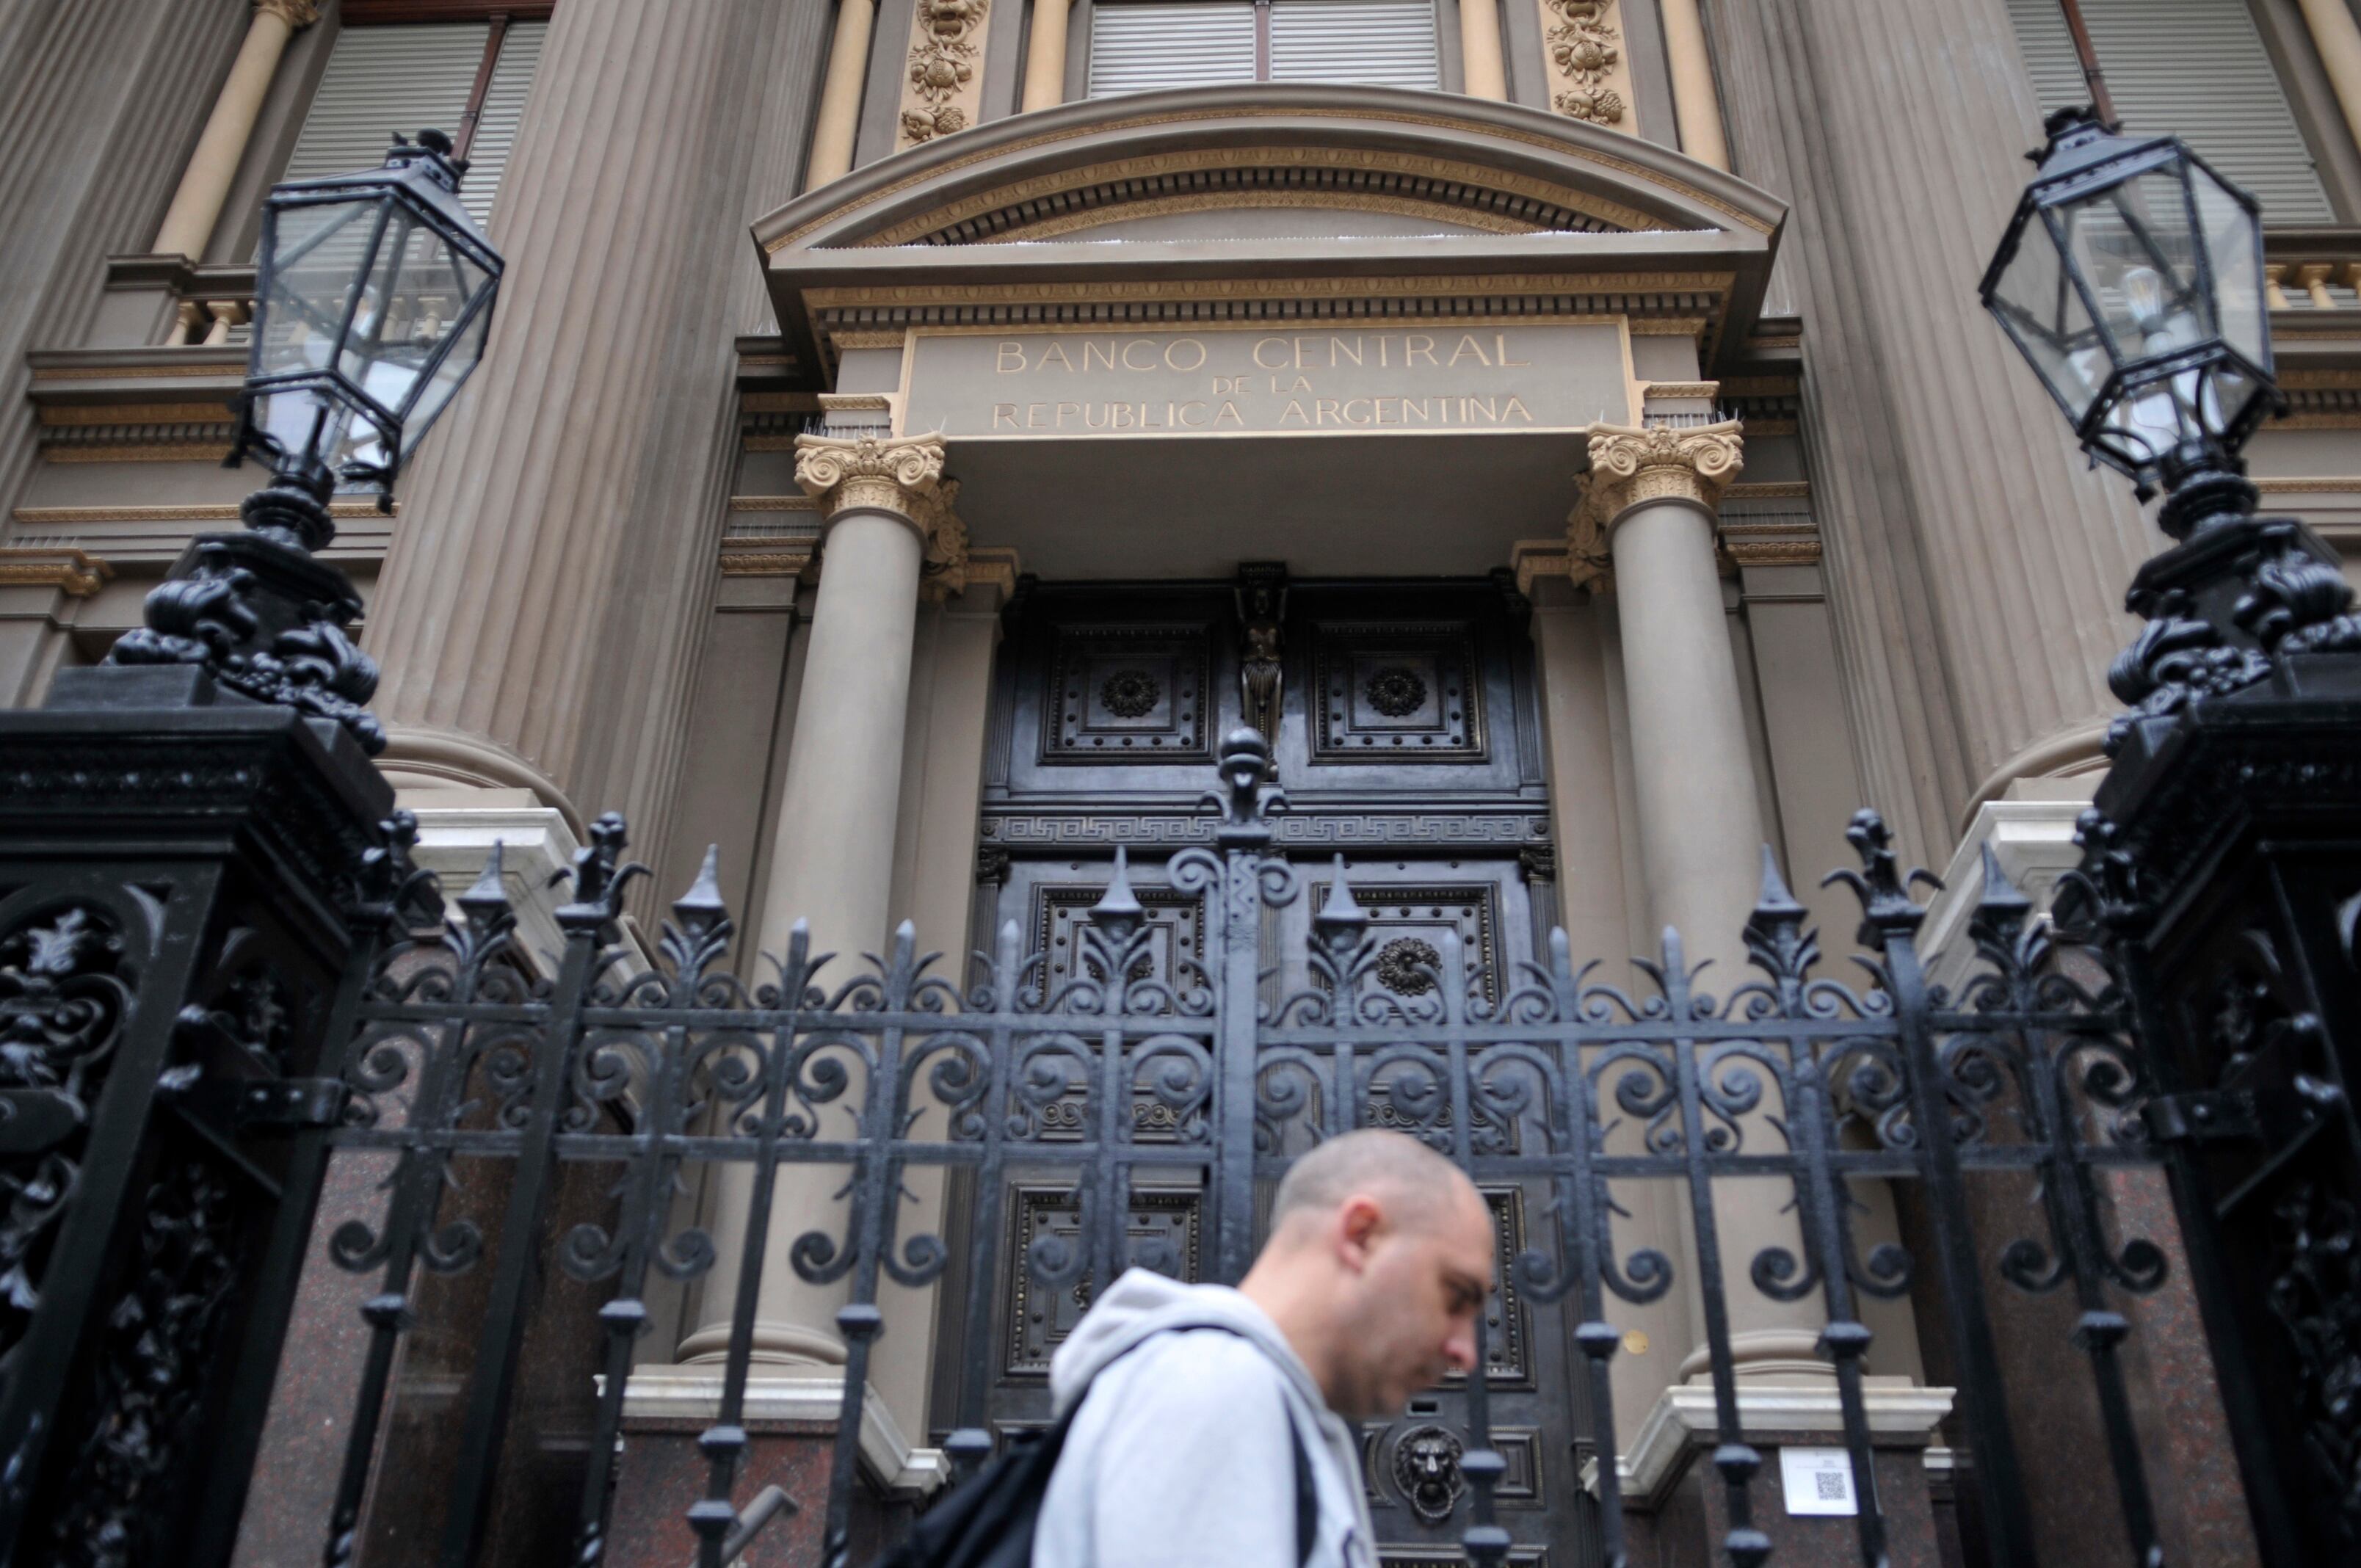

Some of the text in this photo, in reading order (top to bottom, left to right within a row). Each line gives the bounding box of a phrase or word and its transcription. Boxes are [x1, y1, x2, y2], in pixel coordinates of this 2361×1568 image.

[996, 334, 1531, 372] BANCO CENTRAL
[1213, 374, 1312, 394] DE LA
[993, 395, 1533, 429] REPUBLICA ARGENTINA
